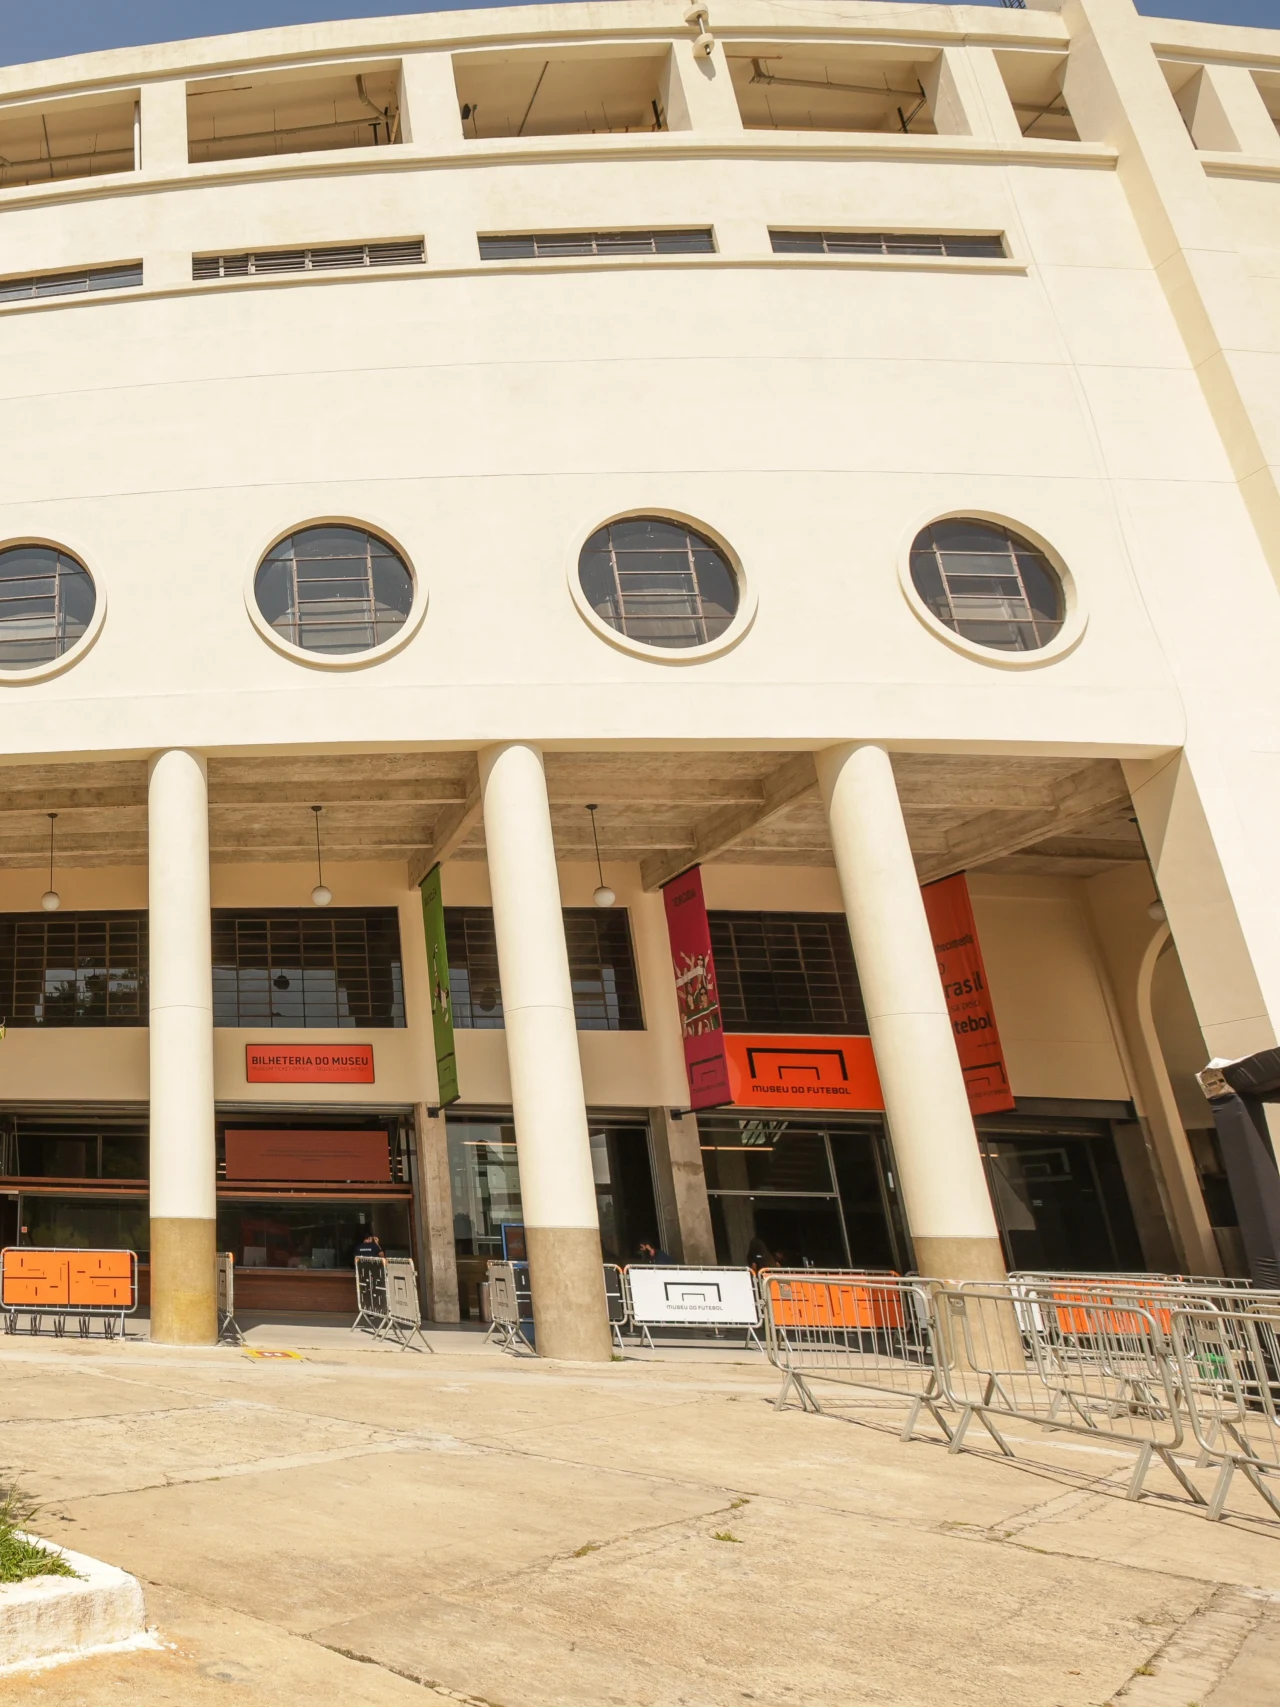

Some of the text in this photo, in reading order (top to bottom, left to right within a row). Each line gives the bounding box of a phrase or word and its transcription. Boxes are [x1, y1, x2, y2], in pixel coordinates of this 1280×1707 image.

[945, 970, 984, 999] rasil
[954, 1011, 993, 1034] tebol
[251, 1056, 369, 1065] BILHETERIA DO MUSEU
[752, 1085, 789, 1093] MUSEU
[807, 1087, 851, 1095] FUTEBOL
